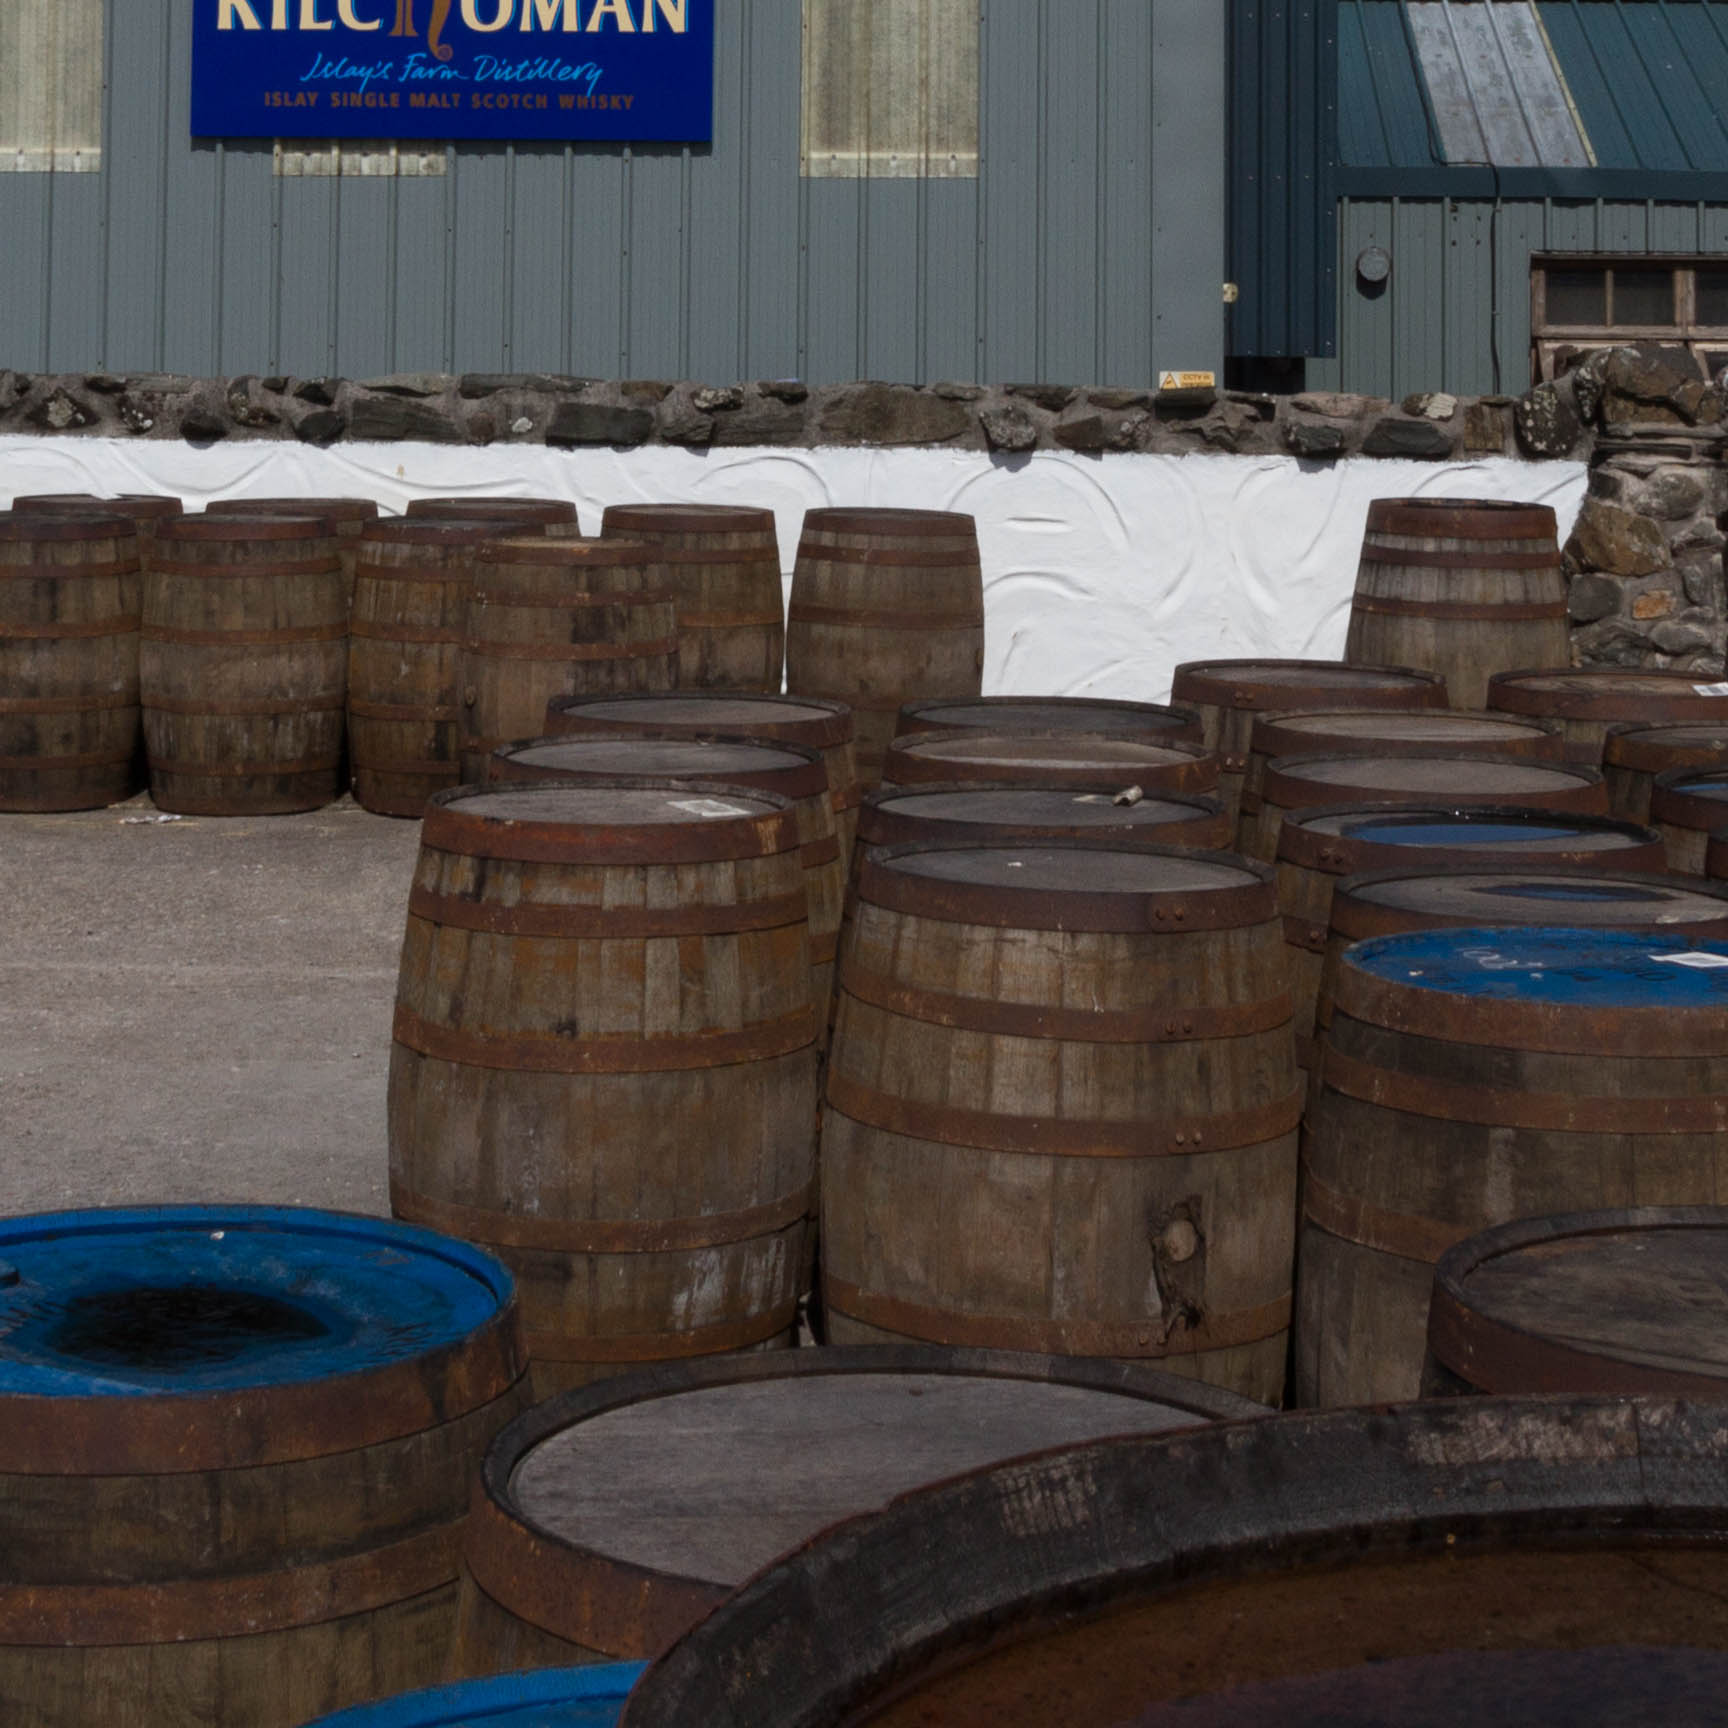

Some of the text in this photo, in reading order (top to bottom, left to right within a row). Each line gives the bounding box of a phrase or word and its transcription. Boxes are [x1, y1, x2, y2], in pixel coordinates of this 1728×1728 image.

[299, 51, 604, 98] Islay's Farm Distillery
[263, 90, 635, 111] ISLAY SINGLE MALT SCOTCH WHISKY
